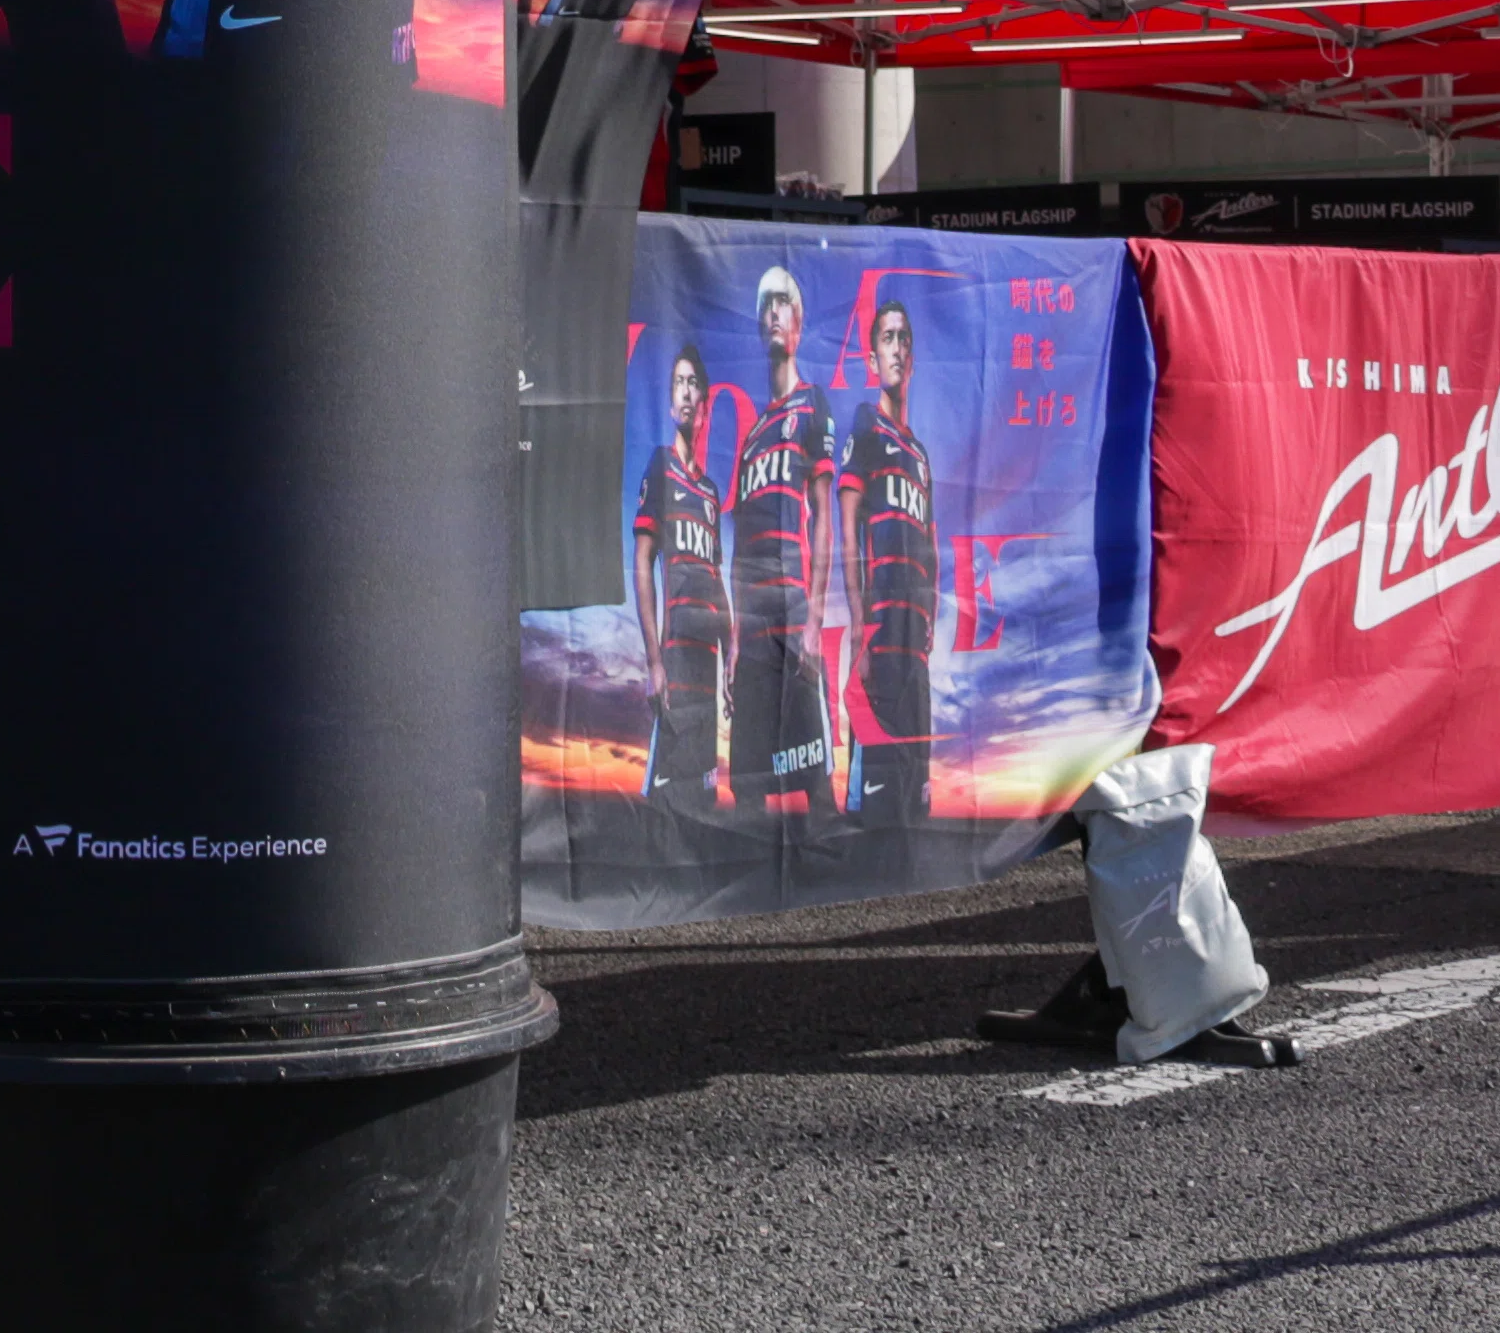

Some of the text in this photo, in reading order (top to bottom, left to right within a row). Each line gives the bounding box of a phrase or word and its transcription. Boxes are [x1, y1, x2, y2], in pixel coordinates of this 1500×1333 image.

[931, 211, 1000, 230] STADIUM
[1002, 207, 1077, 226] FLAGSHIP
[1310, 203, 1387, 220] STADIUM
[1390, 200, 1475, 219] FLAGSHIP
[1010, 276, 1076, 314] 時代の
[1297, 356, 1452, 396] KSHIMA
[1008, 389, 1078, 428] 上げろ
[740, 449, 793, 502] LIXIL
[950, 533, 1058, 654] E
[12, 834, 34, 857] A
[77, 831, 186, 860] Fanatics
[191, 832, 328, 865] Experience
